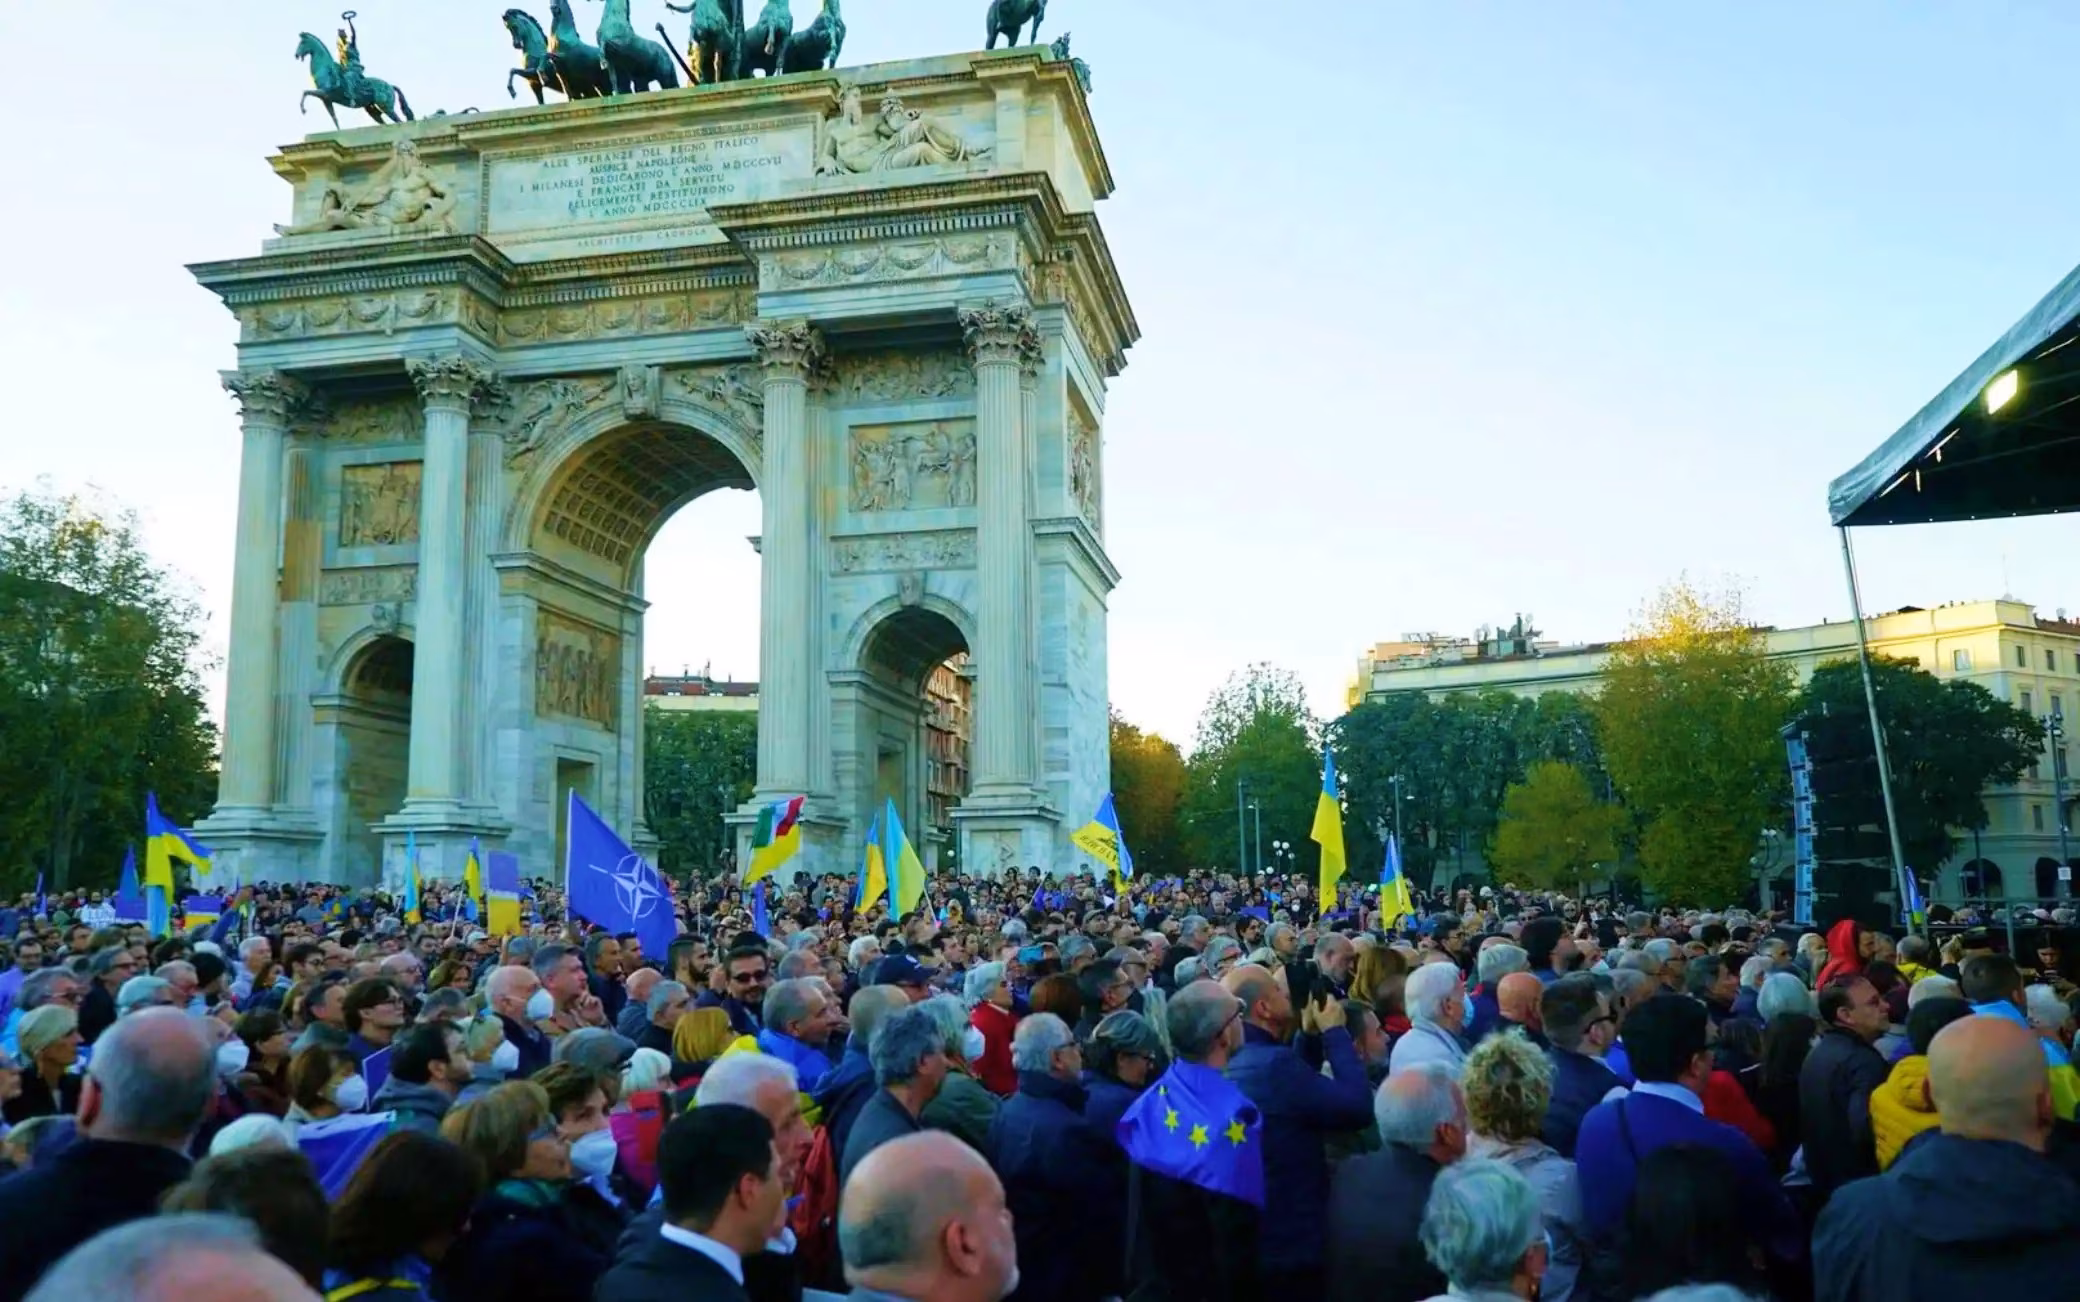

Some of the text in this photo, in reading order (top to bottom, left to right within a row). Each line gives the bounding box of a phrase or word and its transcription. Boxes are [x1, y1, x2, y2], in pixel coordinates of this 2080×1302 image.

[642, 148, 660, 157] DEL
[671, 142, 706, 154] REGNO
[714, 136, 758, 149] ITALICO
[636, 154, 697, 168] NAPOLEONE
[651, 184, 735, 200] RESTITUIRONO
